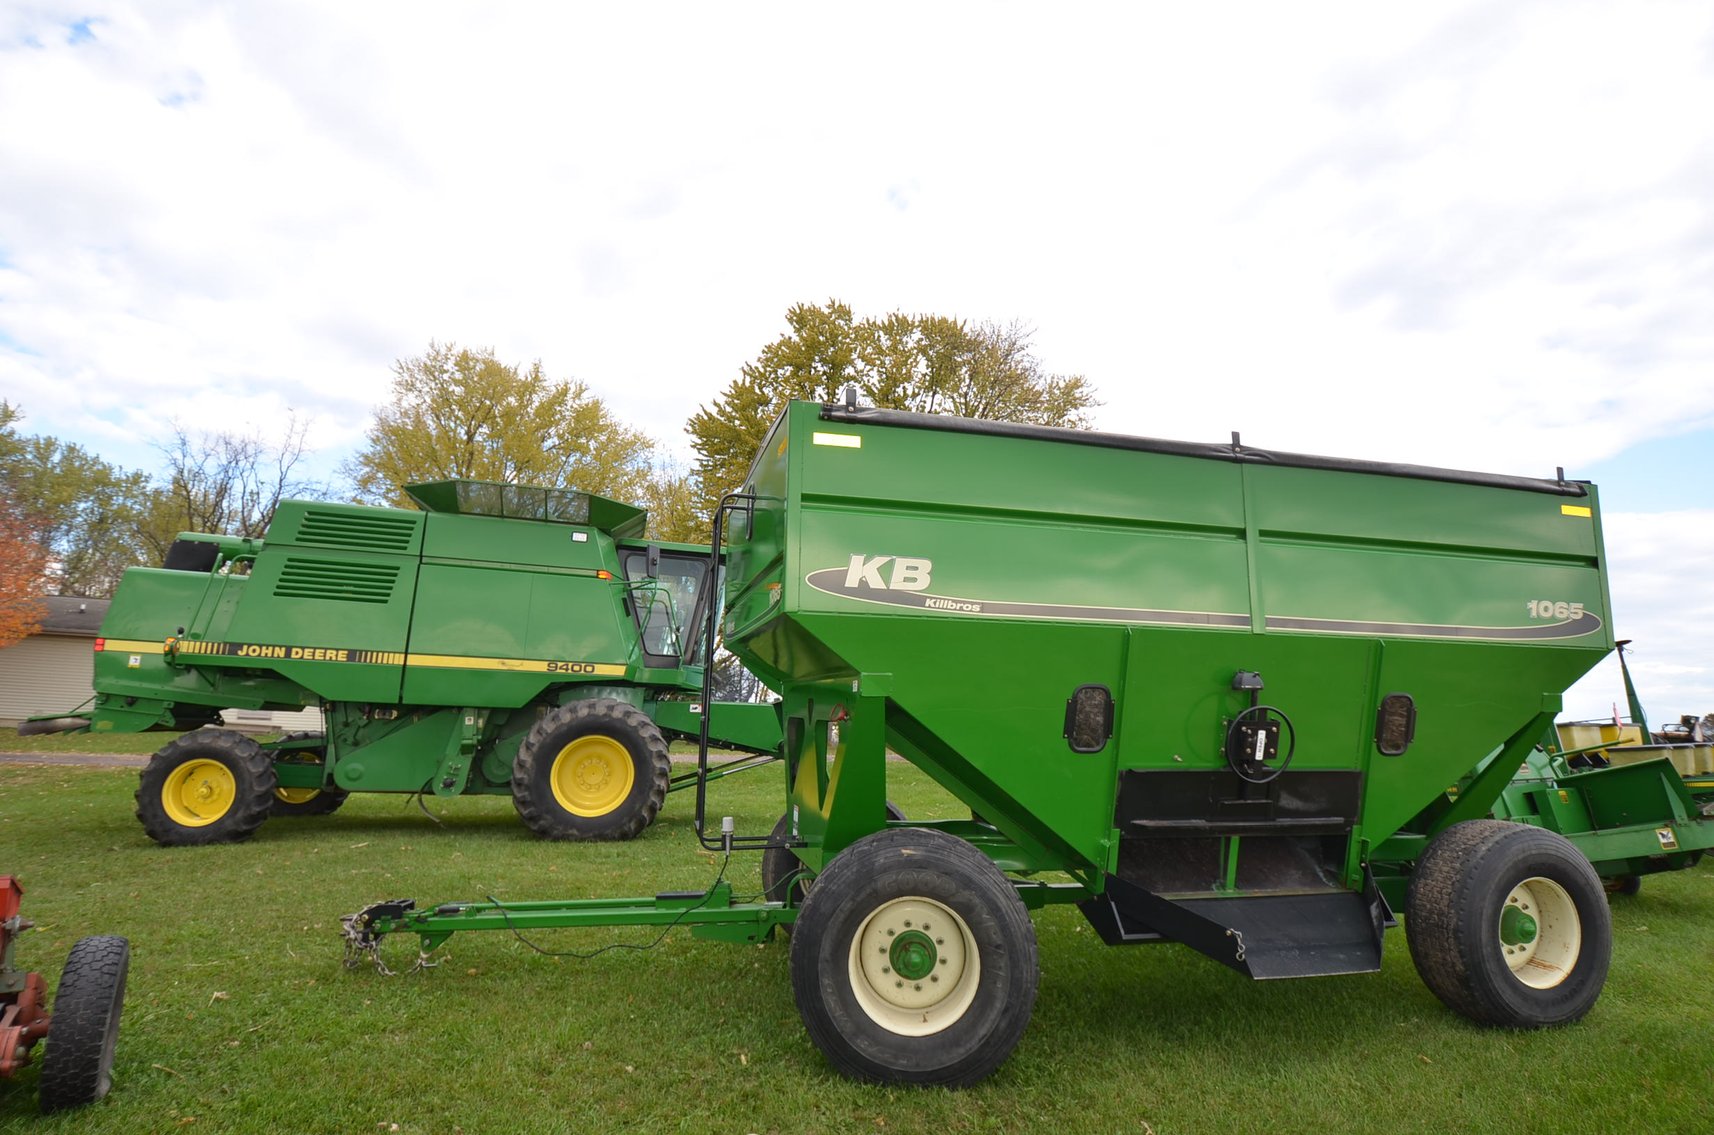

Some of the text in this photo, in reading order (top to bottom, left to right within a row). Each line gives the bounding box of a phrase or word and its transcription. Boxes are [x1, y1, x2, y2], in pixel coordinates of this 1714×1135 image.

[844, 555, 932, 591] KB
[925, 599, 981, 612] Killbros
[1527, 601, 1584, 619] 1065
[238, 646, 348, 661] JOHN DEERE
[547, 662, 595, 674] 9400
